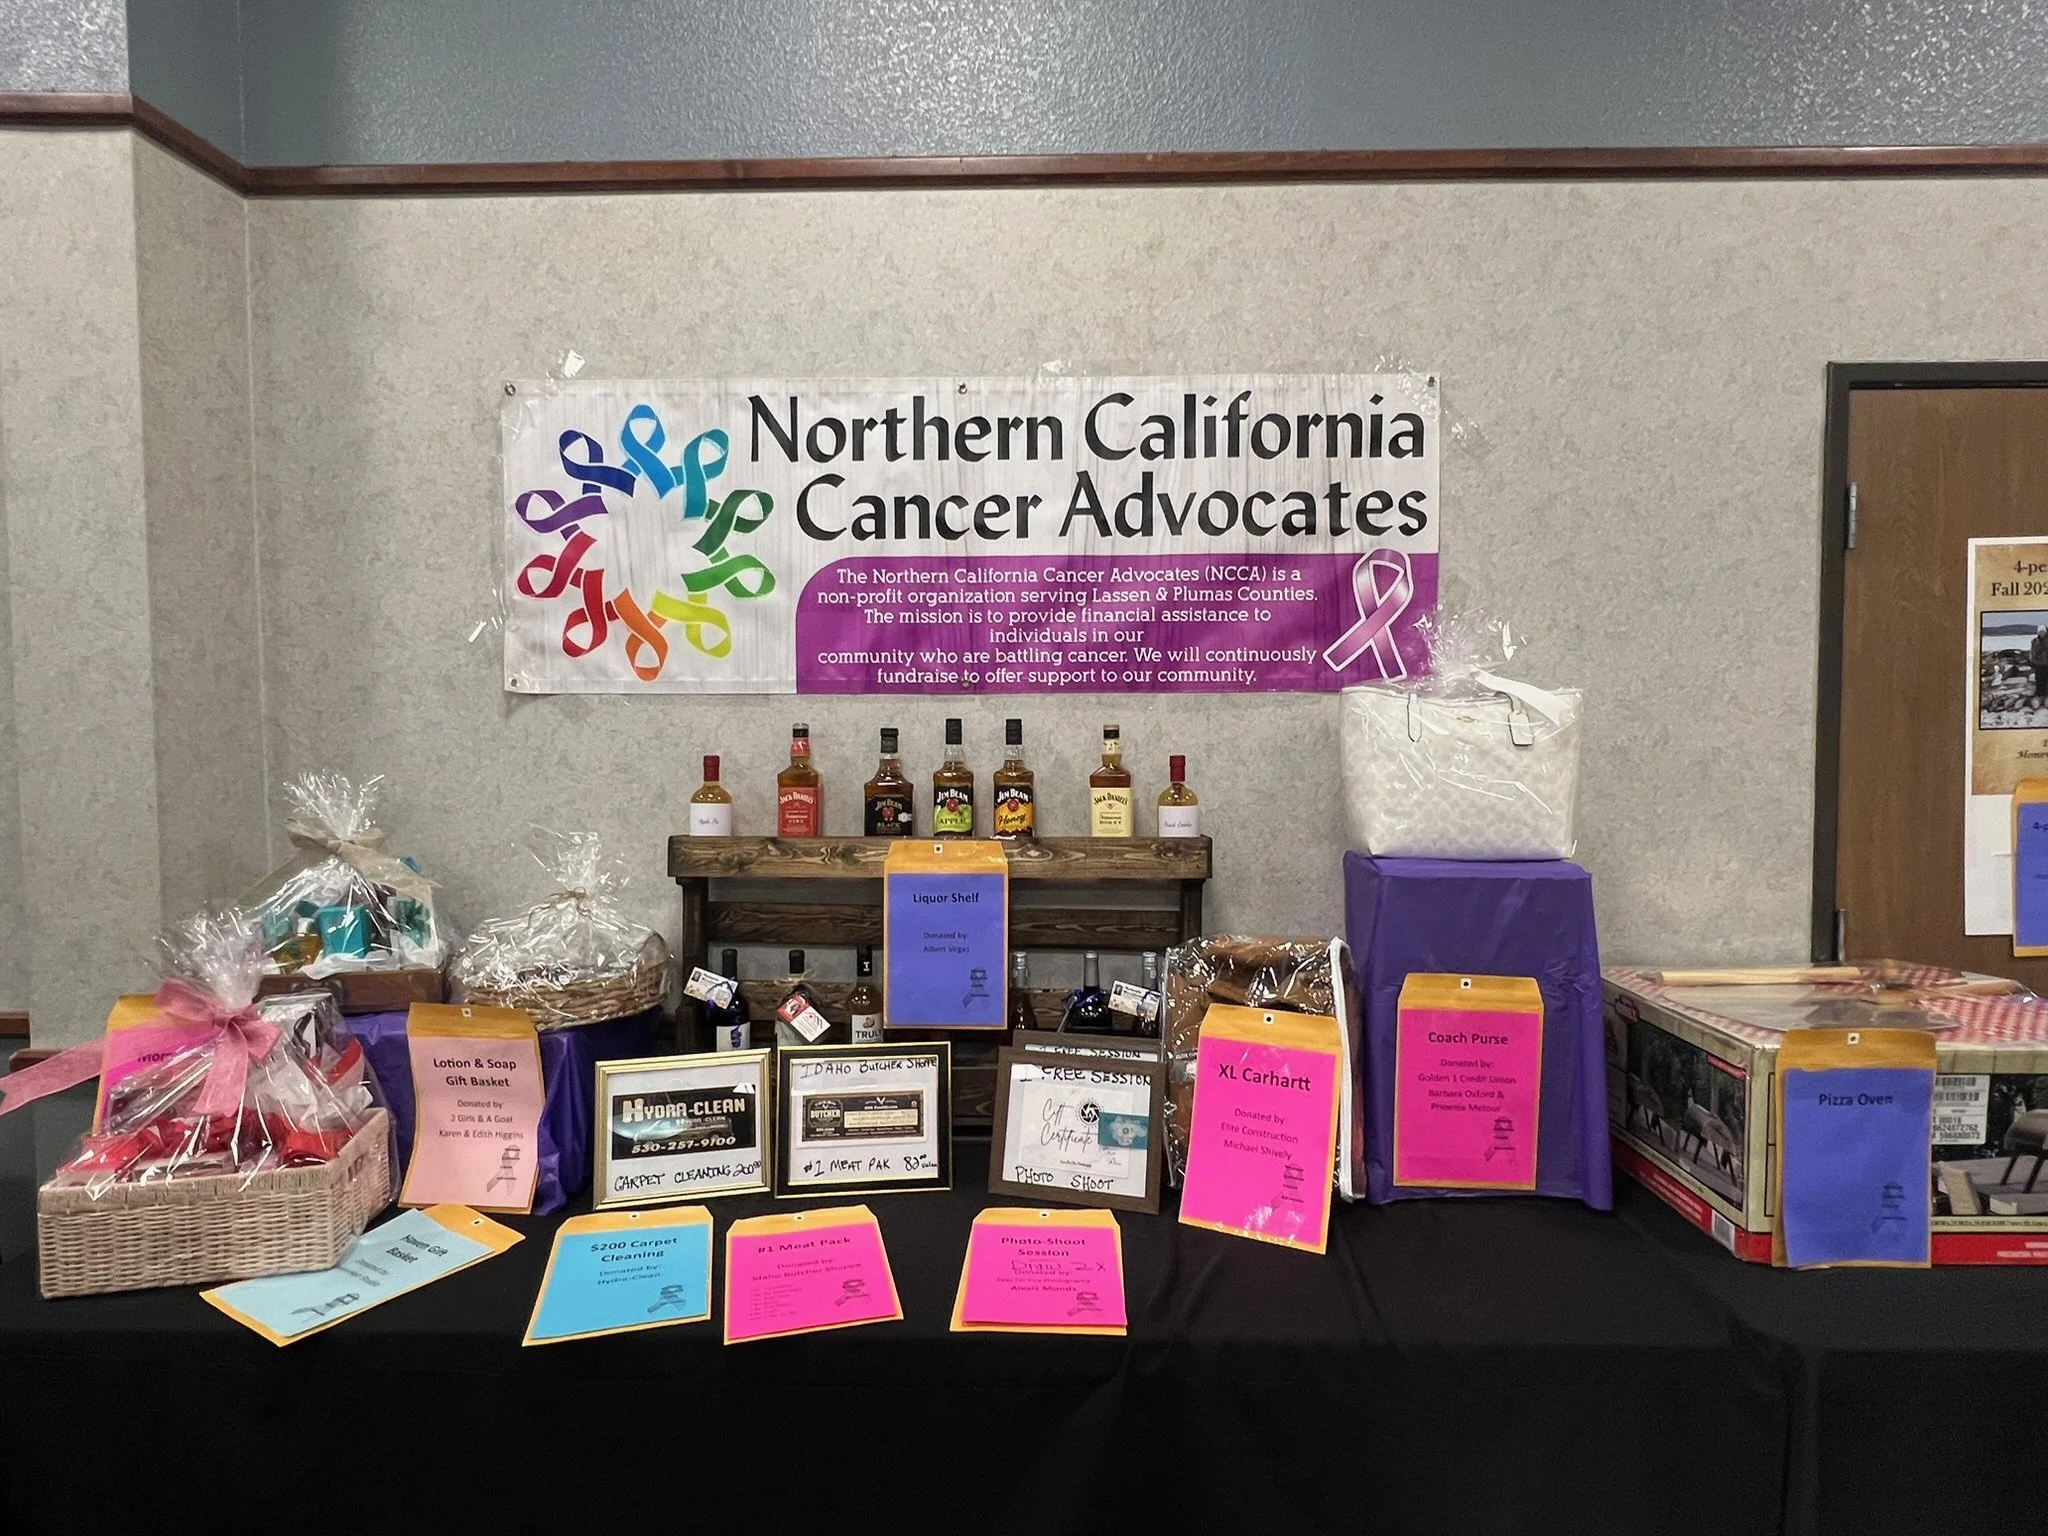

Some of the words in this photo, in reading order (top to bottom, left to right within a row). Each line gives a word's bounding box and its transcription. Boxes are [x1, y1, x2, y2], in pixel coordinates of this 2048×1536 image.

[748, 394, 1063, 462] Northern
[1085, 391, 1424, 460] California
[797, 474, 1042, 541] Cancer
[1059, 471, 1427, 538] Advocates
[837, 569, 868, 584] The
[873, 568, 949, 584] Northern
[954, 568, 1038, 583] California
[1043, 567, 1105, 583] Cancer
[1110, 567, 1200, 582] Advocates
[1205, 566, 1267, 582] (NCCA)
[1272, 567, 1286, 580] is
[1290, 570, 1302, 581] a
[817, 588, 903, 607] non-profit
[908, 589, 1016, 607] organization
[1020, 589, 1087, 606] serving
[1092, 587, 1151, 603] Lassen
[1155, 587, 1168, 602] &
[1173, 586, 1233, 602] Plumas
[1237, 586, 1318, 602] Counties.
[1991, 582, 2019, 596] Fall
[864, 609, 895, 624] The
[899, 609, 964, 623] mission
[968, 609, 983, 623] is
[987, 610, 1004, 623] to
[1008, 608, 1077, 626] provide
[1081, 607, 1156, 623] financial
[1161, 608, 1249, 622] assistance
[1254, 608, 1272, 622] to
[990, 628, 1087, 643] individuals
[1092, 628, 1109, 642] in
[1113, 631, 1145, 642] our
[818, 648, 915, 667] community
[919, 648, 958, 664] who
[963, 653, 990, 664] are
[995, 648, 1063, 667] battling
[1068, 652, 1128, 663] cancer.
[1133, 648, 1162, 662] We
[1167, 647, 1200, 662] will
[1205, 646, 1317, 665] continuously
[877, 668, 959, 684] fundraise
[963, 669, 980, 684] to
[985, 668, 1024, 683] offer
[1028, 669, 1096, 686] support
[1101, 670, 1118, 683] to
[1122, 672, 1153, 683] our
[1157, 668, 1257, 685] community.
[937, 790, 949, 803] JIM
[950, 788, 968, 802] BEAM
[997, 790, 1009, 803] JIM
[1010, 788, 1028, 802] BEAM
[940, 817, 966, 825] APPLE
[999, 814, 1026, 826] Honey
[913, 893, 948, 906] Liquor
[951, 892, 980, 903] Shelf
[923, 932, 956, 940] Donated
[855, 1030, 882, 1039] TRULY
[1428, 1032, 1468, 1044] Coach
[1472, 1033, 1509, 1045] Purse
[433, 1058, 471, 1069] Lotion
[474, 1059, 484, 1069] &
[487, 1060, 517, 1072] Soap
[800, 1063, 851, 1079] IDAHO
[1440, 1059, 1478, 1068] Donated
[446, 1075, 467, 1087] Gift
[470, 1077, 510, 1088] Basket
[1091, 1071, 1151, 1086] SESSION
[1218, 1063, 1238, 1080] XL
[1242, 1067, 1311, 1091] Carhartt
[1418, 1074, 1450, 1084] Golden
[1460, 1075, 1487, 1084] Credit
[1489, 1075, 1516, 1084] Union
[1428, 1089, 1462, 1098] Barbara
[1464, 1089, 1495, 1098] Oxford
[1819, 1093, 1853, 1106] Pizza
[1857, 1093, 1893, 1106] Oven
[457, 1099, 491, 1108] Donated
[622, 1097, 746, 1124] HYDRA-CLEAN
[458, 1114, 475, 1123] Girls
[486, 1115, 493, 1123] A
[494, 1115, 513, 1123] Goat
[1234, 1107, 1272, 1122] Donated
[439, 1128, 462, 1137] Karen
[463, 1129, 470, 1137] &
[472, 1129, 493, 1138] Edith
[495, 1131, 524, 1141] Higgins
[1221, 1123, 1240, 1134] Elite
[1241, 1126, 1298, 1144] Construction
[631, 1136, 737, 1154] 530-257-9100
[1224, 1140, 1258, 1154] Michael
[1260, 1146, 1292, 1161] Shively
[830, 1159, 863, 1172] MEAT
[868, 1157, 891, 1172] PAK
[614, 1173, 666, 1192] CARPET
[674, 1165, 732, 1184] CLEANING
[1015, 1165, 1055, 1184] PHOTO
[1070, 1175, 1115, 1192] SHOOT
[427, 1245, 449, 1257] Gift
[590, 1241, 627, 1253] $200
[630, 1236, 679, 1251] Carpet
[758, 1246, 773, 1254] #1
[779, 1241, 814, 1252] Meat
[820, 1237, 851, 1247] Pack
[386, 1246, 419, 1264] Basket
[601, 1250, 665, 1263] Cleaning
[1018, 1249, 1070, 1257] Session
[597, 1272, 661, 1285] Hydra-Clean
[599, 1265, 644, 1277] Donated
